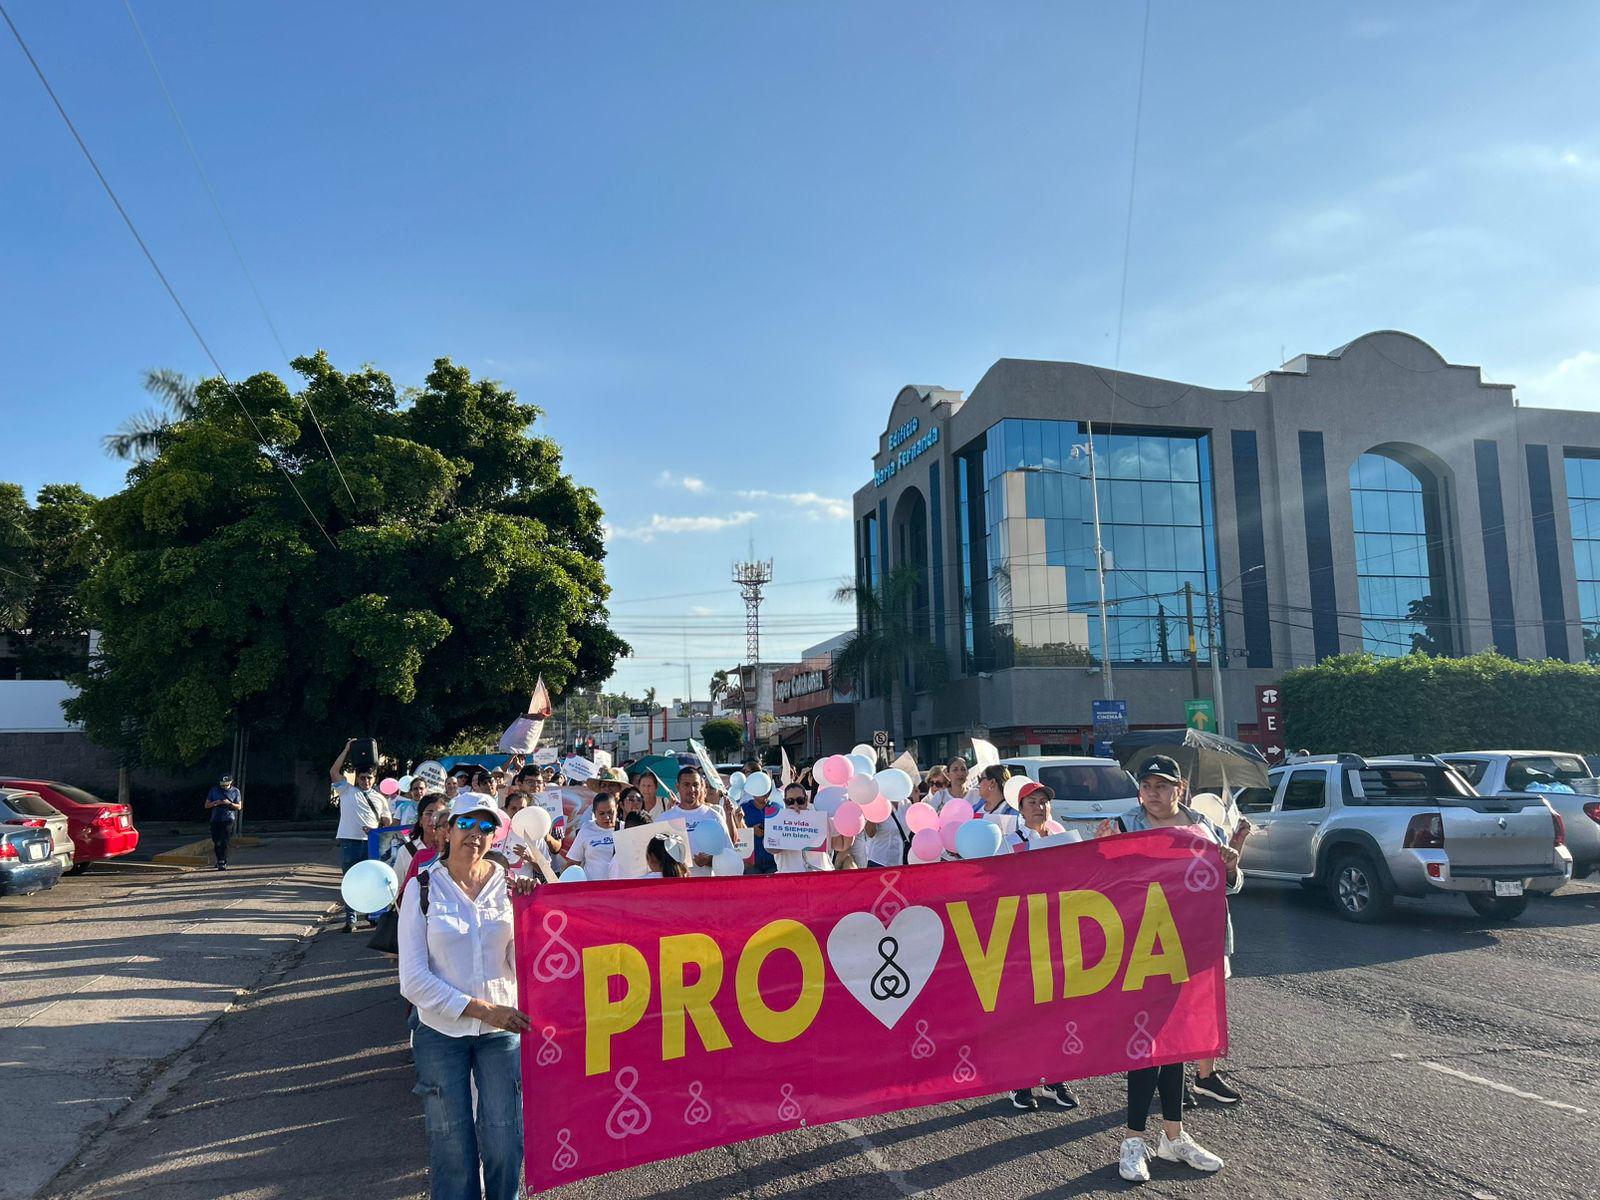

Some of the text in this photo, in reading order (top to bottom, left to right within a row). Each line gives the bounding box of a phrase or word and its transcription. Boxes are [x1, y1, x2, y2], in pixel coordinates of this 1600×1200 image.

[898, 426, 939, 470] Fernanda
[1267, 716, 1276, 731] E
[582, 882, 1190, 1076] PRO VIDA
